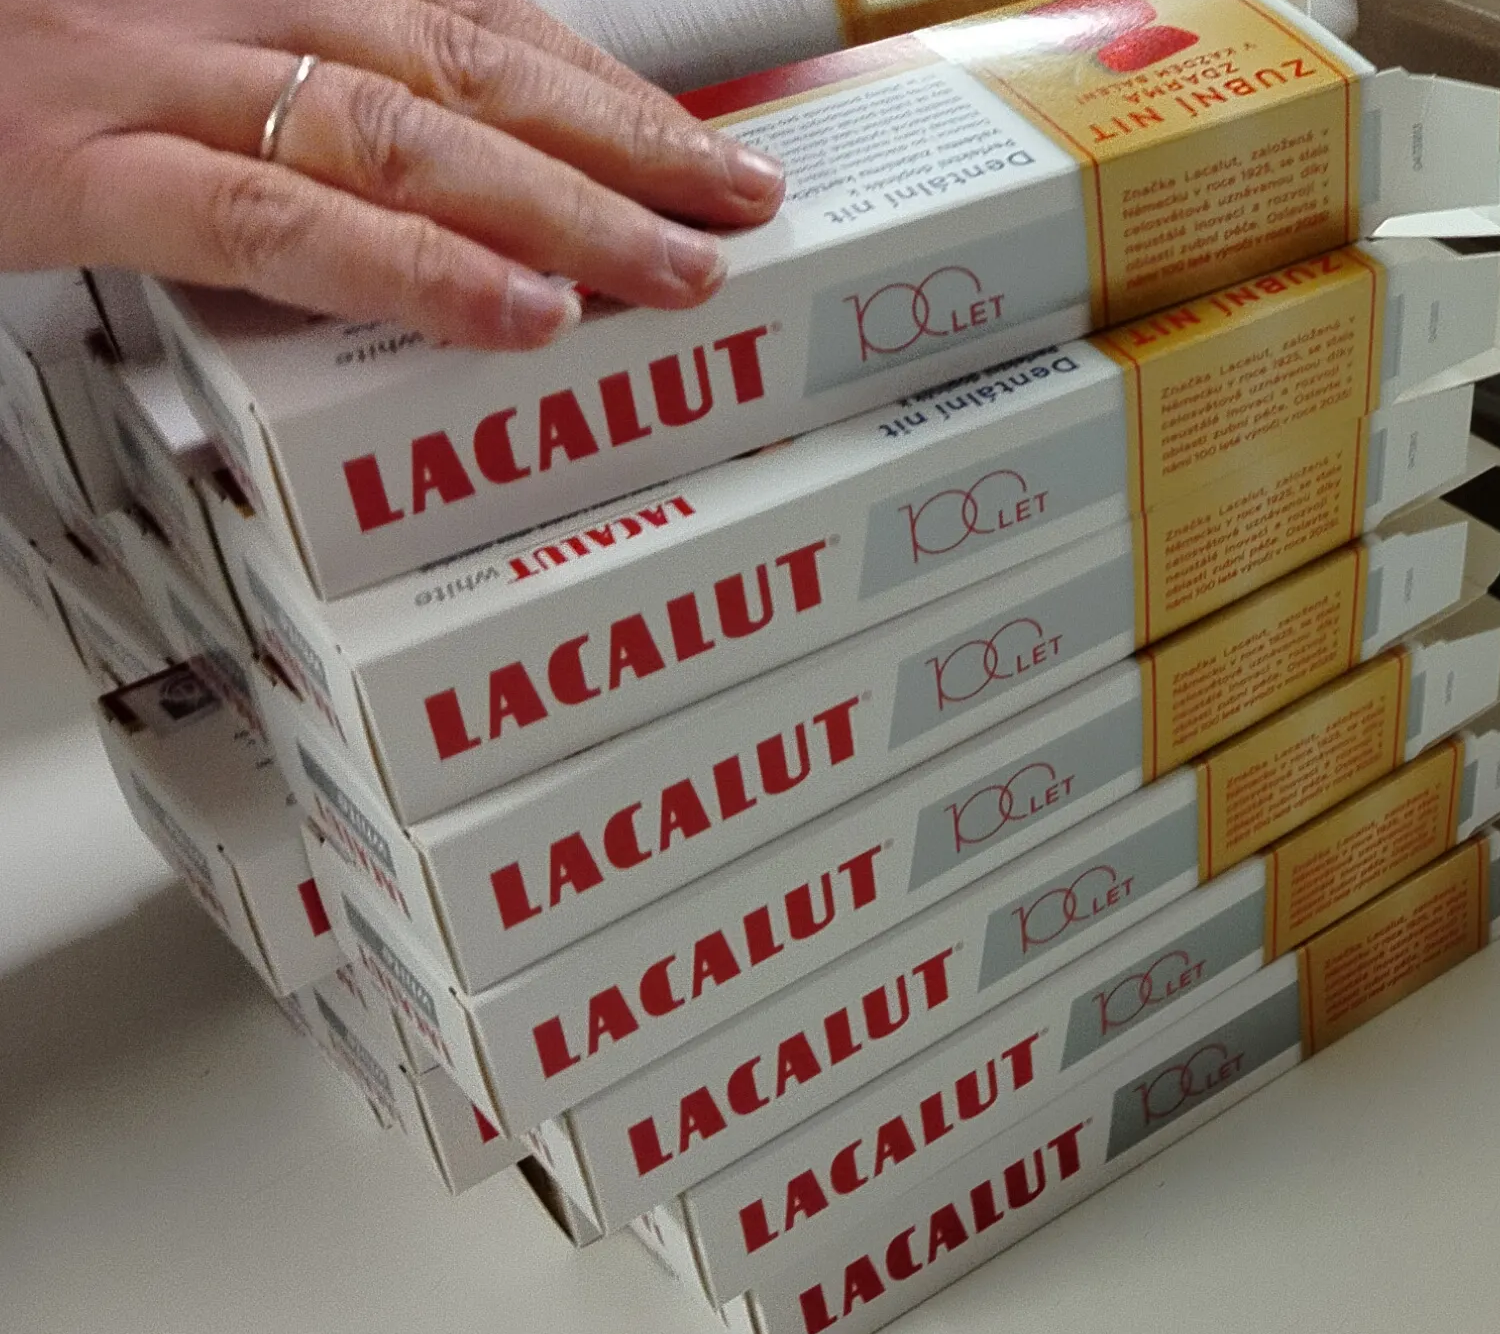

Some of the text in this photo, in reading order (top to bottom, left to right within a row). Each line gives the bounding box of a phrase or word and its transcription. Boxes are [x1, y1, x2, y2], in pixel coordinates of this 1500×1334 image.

[1088, 58, 1317, 144] ZUBNÍ NIT
[1122, 61, 1240, 105] ZDARMA
[821, 147, 1038, 227] Dentální nit
[1125, 308, 1200, 347] NIT
[343, 326, 767, 532] LACALUT
[878, 411, 928, 438] nit
[935, 356, 1078, 421] Dentální
[415, 496, 695, 607] LACALUT white
[424, 540, 826, 760] LACALUT
[490, 697, 859, 929] LACALUT
[533, 845, 882, 1077] LACALUT
[628, 948, 952, 1176] LACALUT
[739, 1034, 1038, 1253] LACALUT
